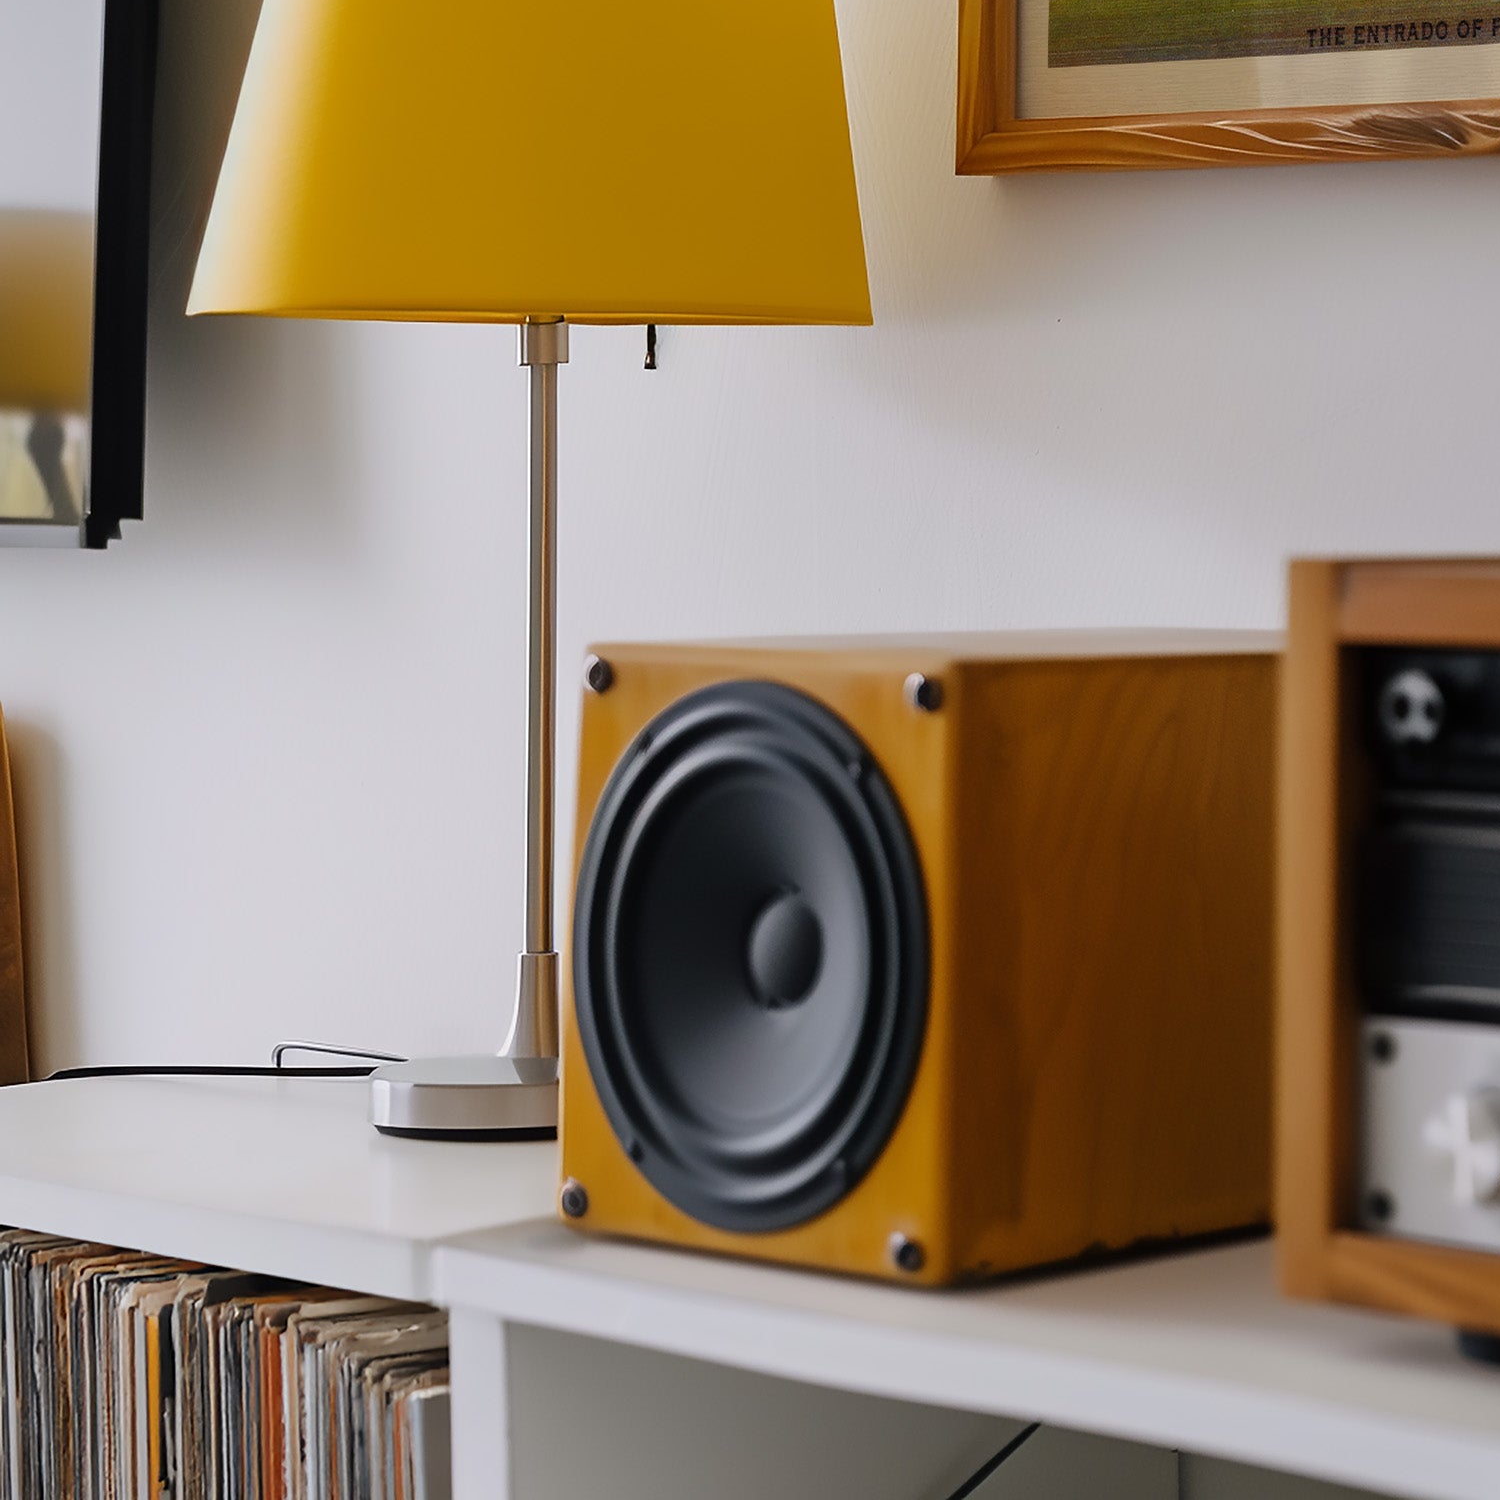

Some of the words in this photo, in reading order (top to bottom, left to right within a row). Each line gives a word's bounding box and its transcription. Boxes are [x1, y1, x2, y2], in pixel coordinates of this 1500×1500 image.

[1306, 26, 1346, 48] THE
[1353, 20, 1450, 45] ENTRADO
[1456, 18, 1483, 39] OF
